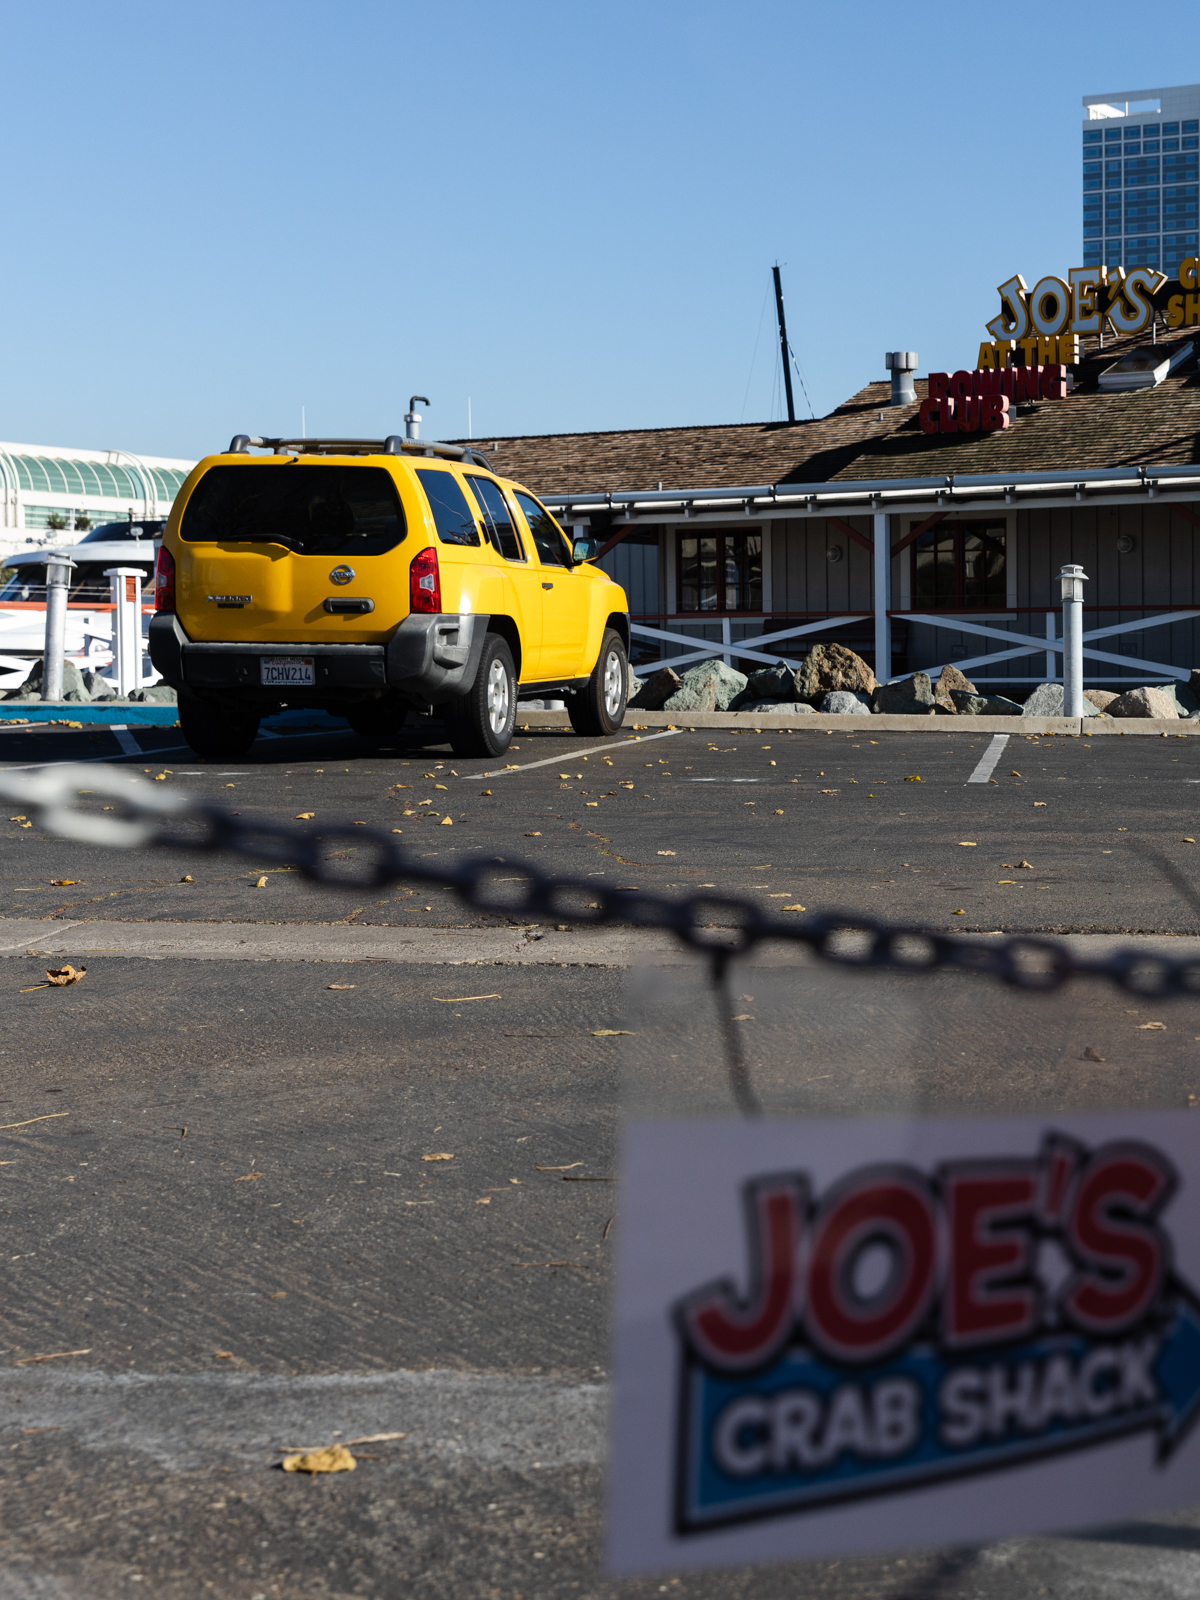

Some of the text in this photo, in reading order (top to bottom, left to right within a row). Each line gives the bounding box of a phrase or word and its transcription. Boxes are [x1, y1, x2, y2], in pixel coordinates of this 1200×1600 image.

[986, 265, 1168, 342] JOE'S
[977, 334, 1080, 370] AT THE
[928, 364, 1067, 401] ROWING
[919, 394, 1010, 434] CLUB
[264, 667, 311, 681] 7CHV214
[676, 1132, 1178, 1372] JOE'S
[714, 1337, 1159, 1474] CRAB SHACK
